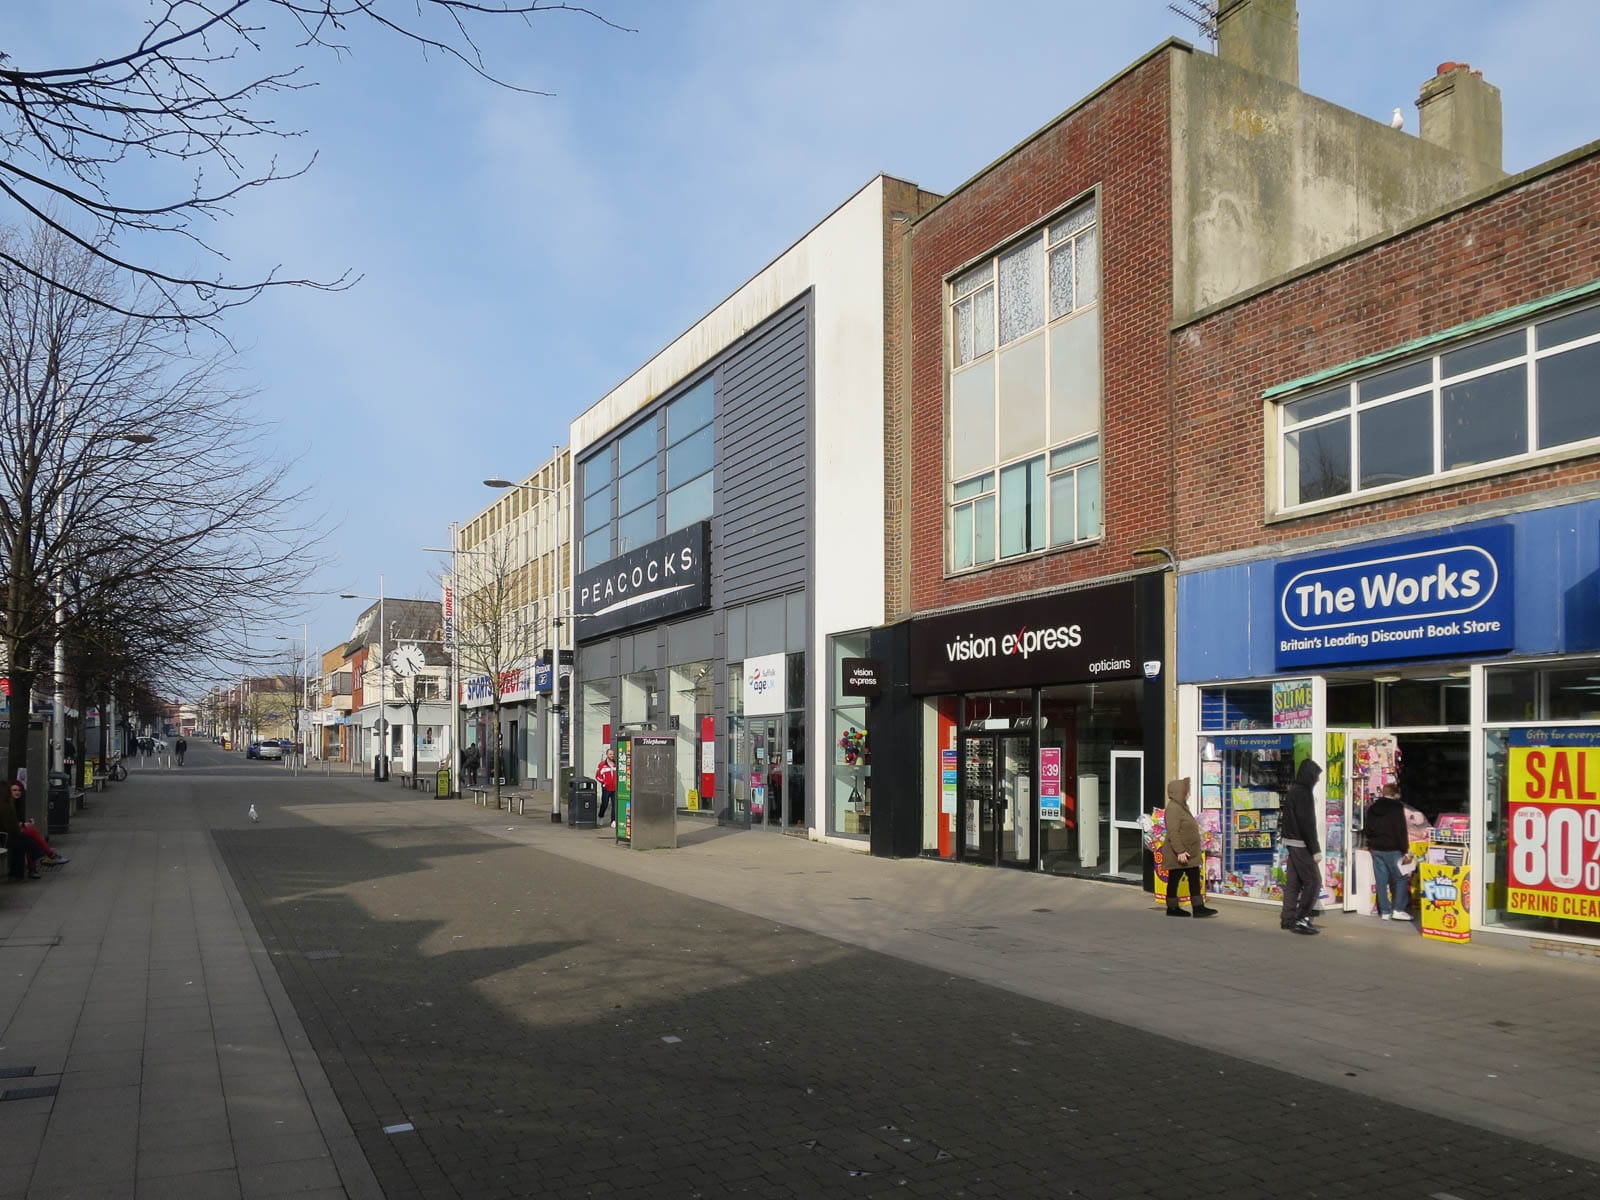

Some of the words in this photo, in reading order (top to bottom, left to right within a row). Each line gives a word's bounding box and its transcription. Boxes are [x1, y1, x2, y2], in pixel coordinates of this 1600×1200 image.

[581, 547, 693, 607] PEACOCKS
[1295, 581, 1355, 617] The
[1360, 563, 1481, 609] Works
[946, 633, 997, 662] vision
[1001, 625, 1082, 660] express
[1280, 636, 1322, 652] Britain's
[1324, 633, 1369, 648] Leading
[1371, 626, 1425, 643] Discount
[1427, 621, 1461, 638] Book
[1463, 619, 1501, 634] Store
[853, 668, 874, 676] vision
[1088, 657, 1132, 675] opticians
[849, 677, 877, 687] express
[1275, 687, 1312, 711] SLIME
[1527, 729, 1549, 739] Gifts
[1551, 729, 1565, 739] for
[1568, 732, 1600, 742] everyo
[1042, 763, 1059, 777] £39
[1525, 750, 1597, 800] SAL
[1511, 892, 1558, 913] SPRING
